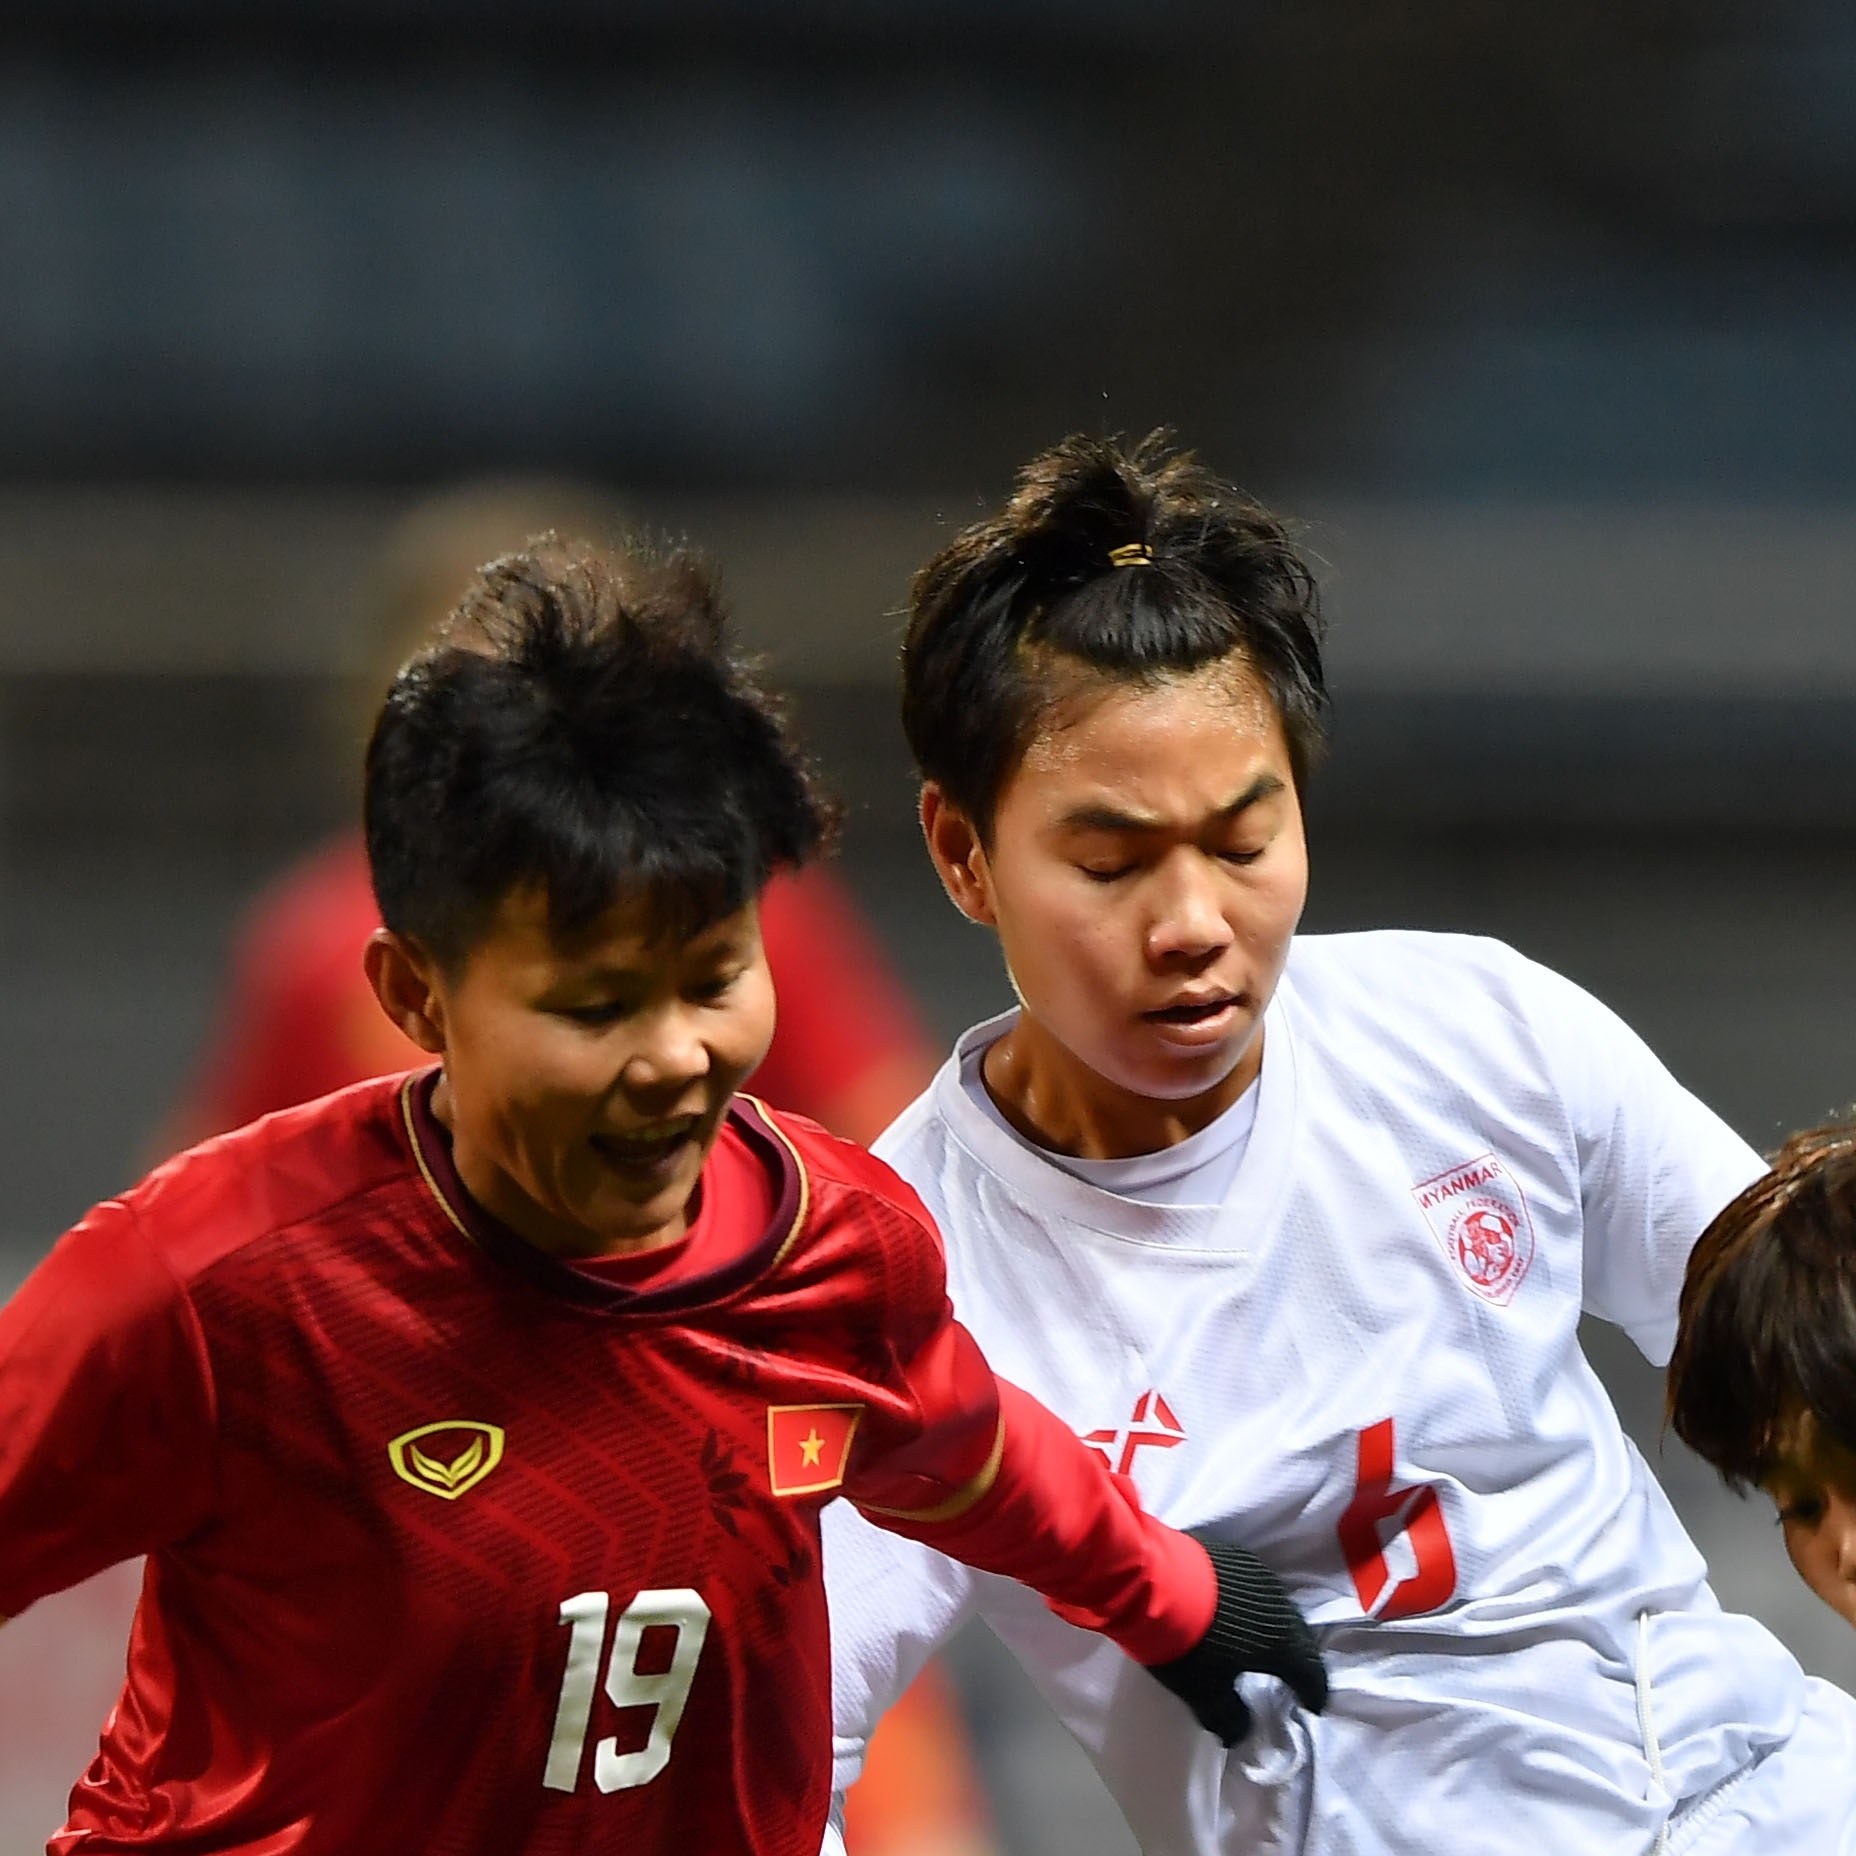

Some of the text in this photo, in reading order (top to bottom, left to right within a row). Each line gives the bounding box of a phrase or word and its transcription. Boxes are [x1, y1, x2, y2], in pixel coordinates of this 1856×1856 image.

[1419, 1161, 1503, 1210] MYANMAR
[1337, 1416, 1457, 1620] 6
[542, 1588, 712, 1794] 19
